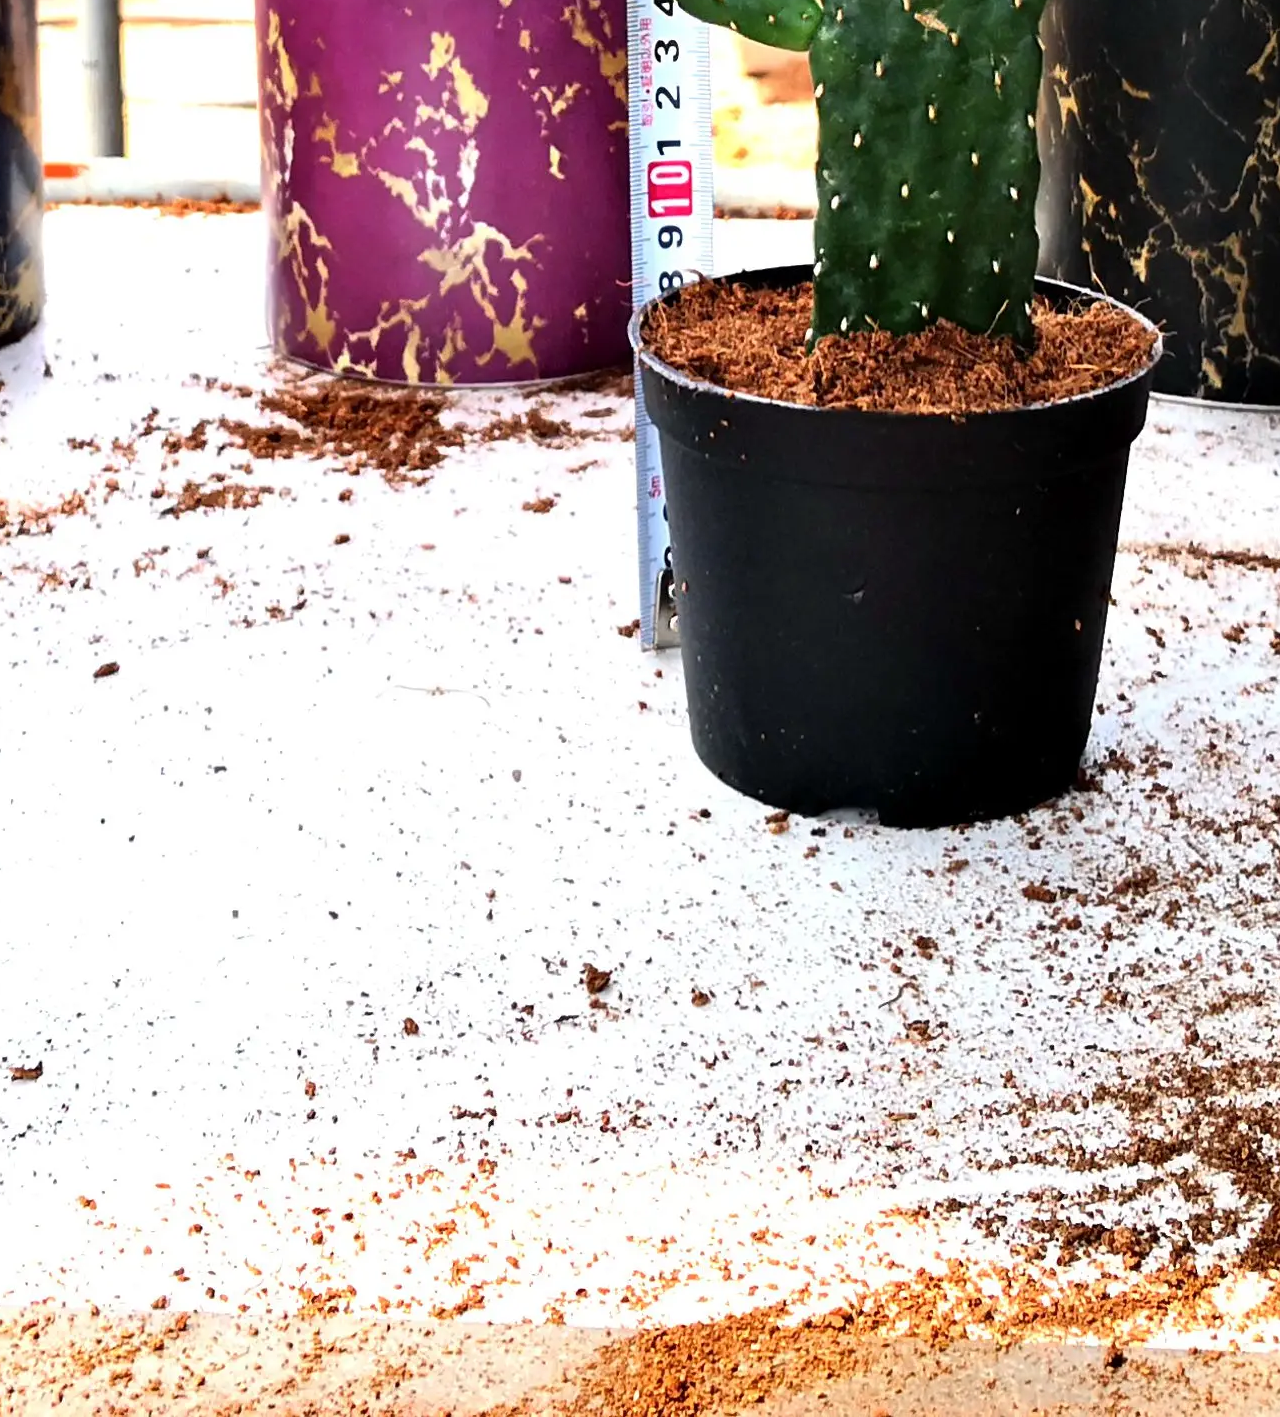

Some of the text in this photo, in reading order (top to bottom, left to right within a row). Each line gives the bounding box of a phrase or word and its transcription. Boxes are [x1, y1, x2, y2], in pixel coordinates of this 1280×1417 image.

[654, 39, 679, 62] 3
[655, 85, 681, 109] 2
[657, 140, 681, 156] 1
[650, 165, 690, 214] 10
[658, 225, 683, 249] 9
